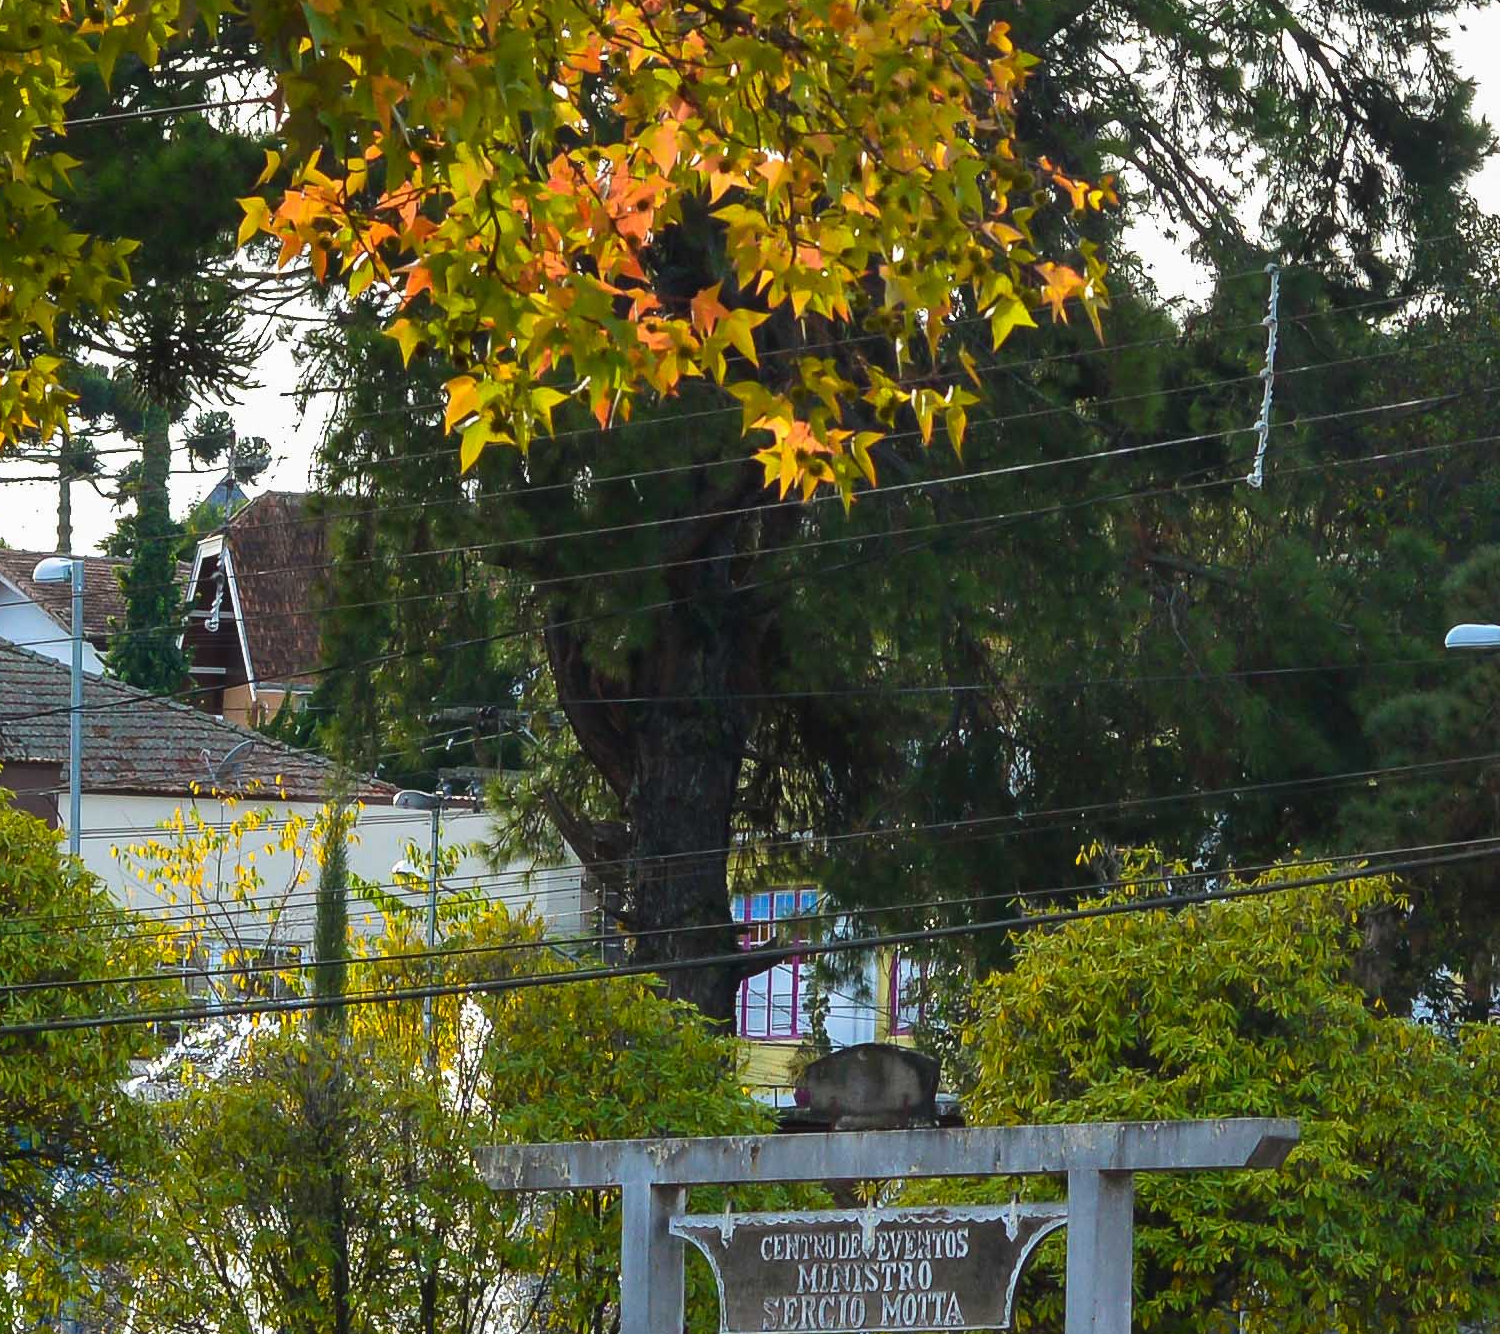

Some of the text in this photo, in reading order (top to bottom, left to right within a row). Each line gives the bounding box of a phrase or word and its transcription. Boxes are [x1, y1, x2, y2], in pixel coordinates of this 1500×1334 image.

[760, 1228, 970, 1261] CENTRO DE EVENTOS
[797, 1262, 933, 1294] MINISTRO
[879, 1291, 965, 1328] MOTTA
